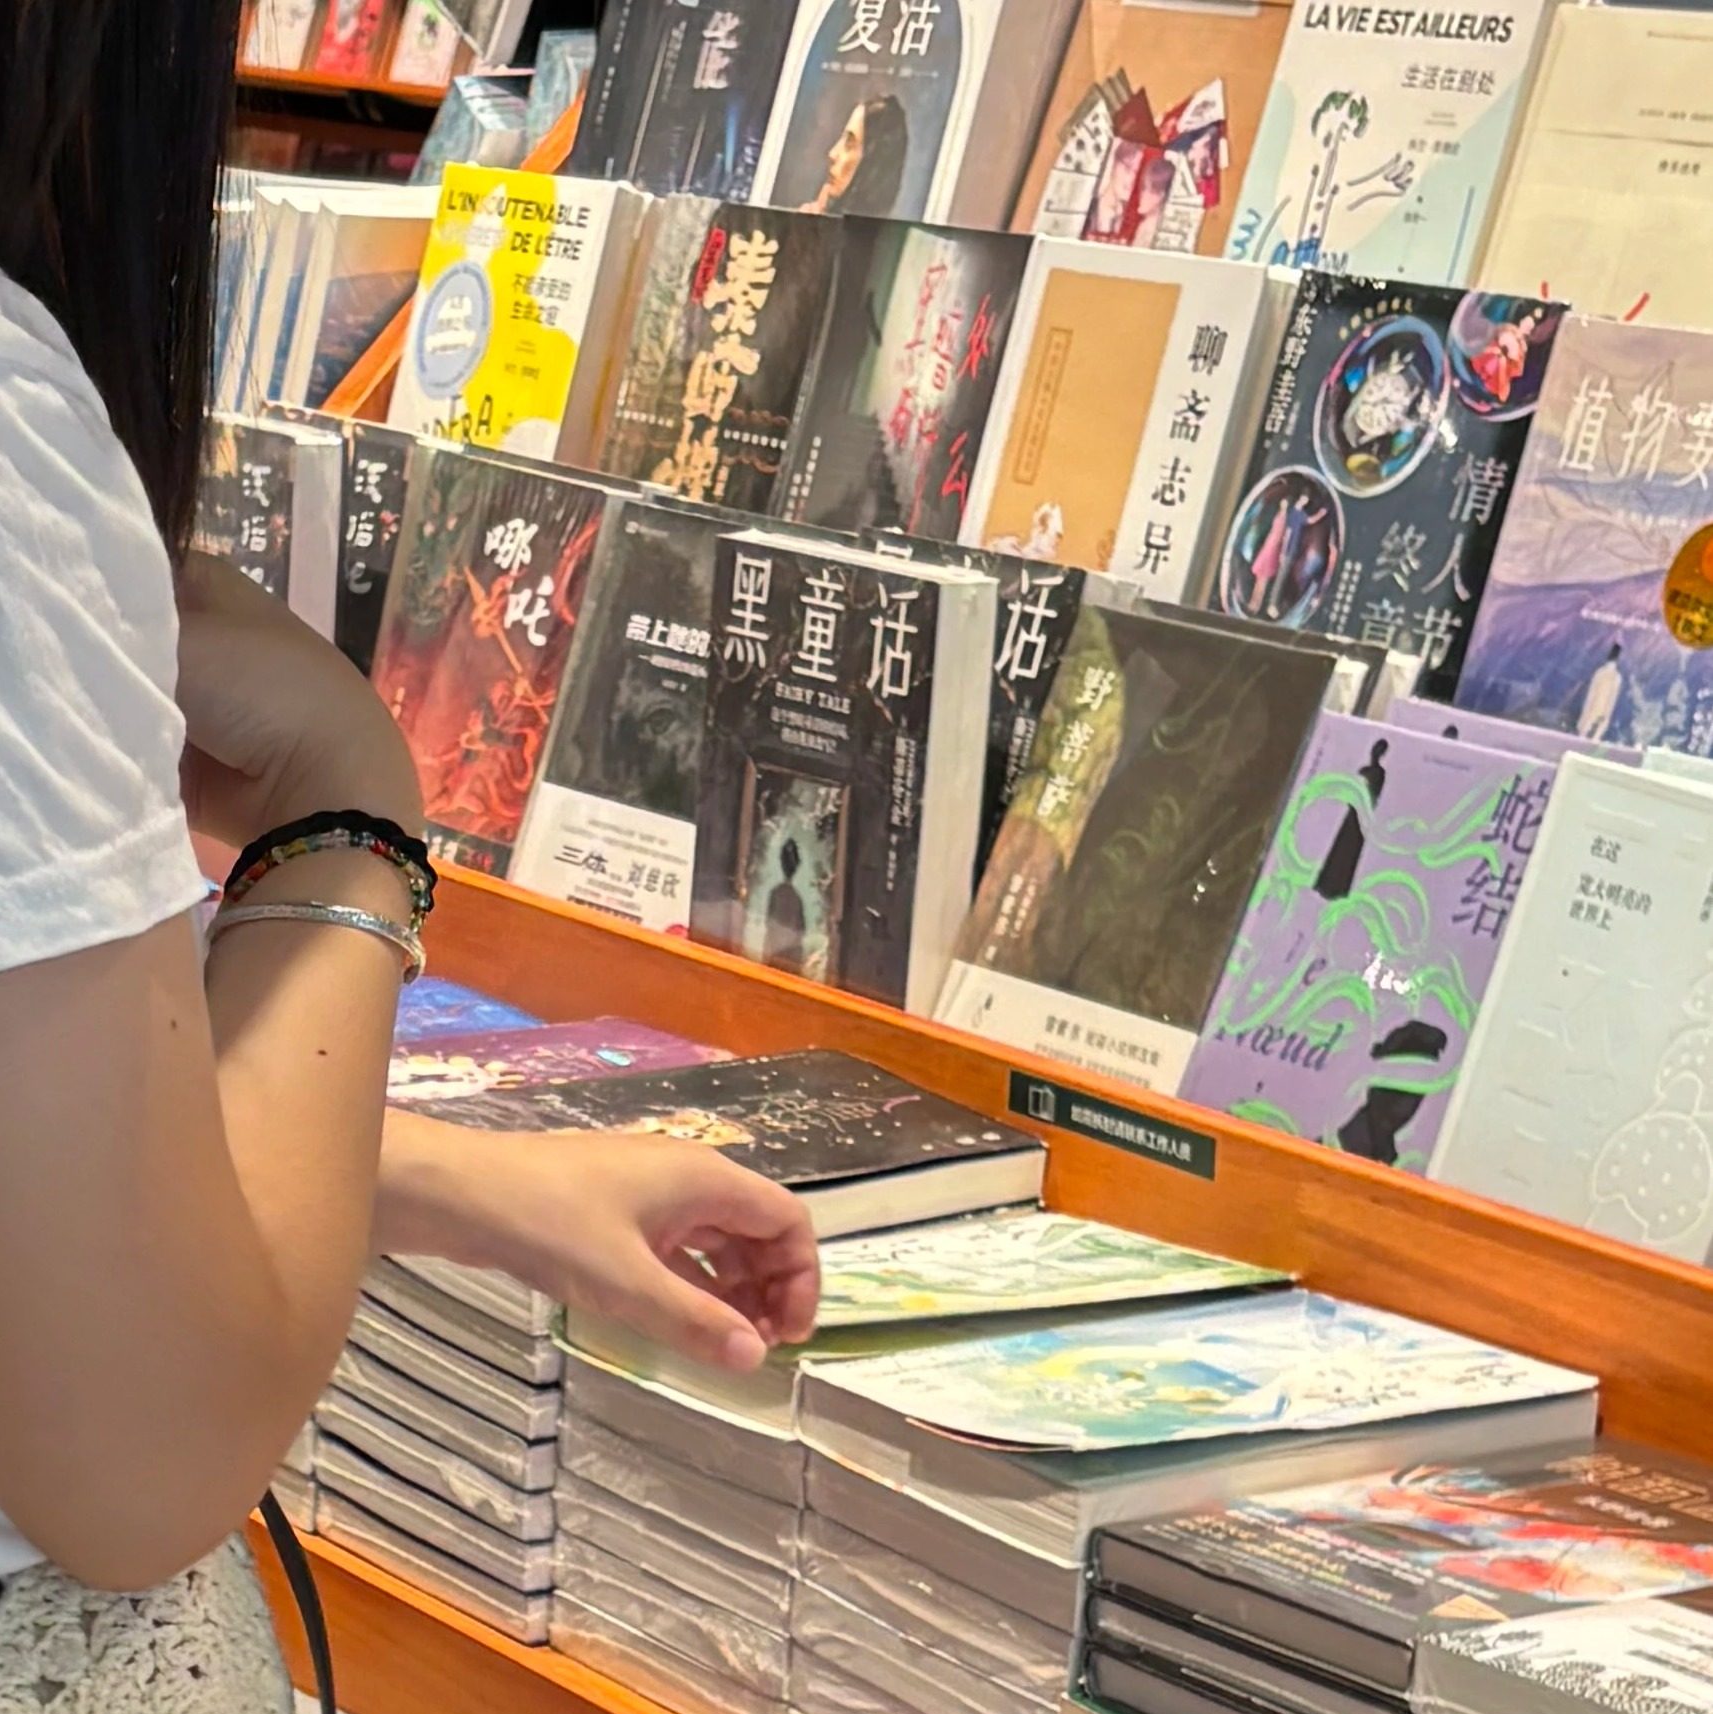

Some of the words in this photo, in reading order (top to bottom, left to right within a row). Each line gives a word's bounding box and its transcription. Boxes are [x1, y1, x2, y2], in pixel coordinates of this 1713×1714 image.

[1304, 5, 1333, 30] LA
[1335, 8, 1372, 34] VIE
[1373, 9, 1414, 37] EST
[1414, 13, 1514, 44] AILLEURS
[485, 517, 554, 646] 哪吒
[723, 552, 919, 698] 黑童话
